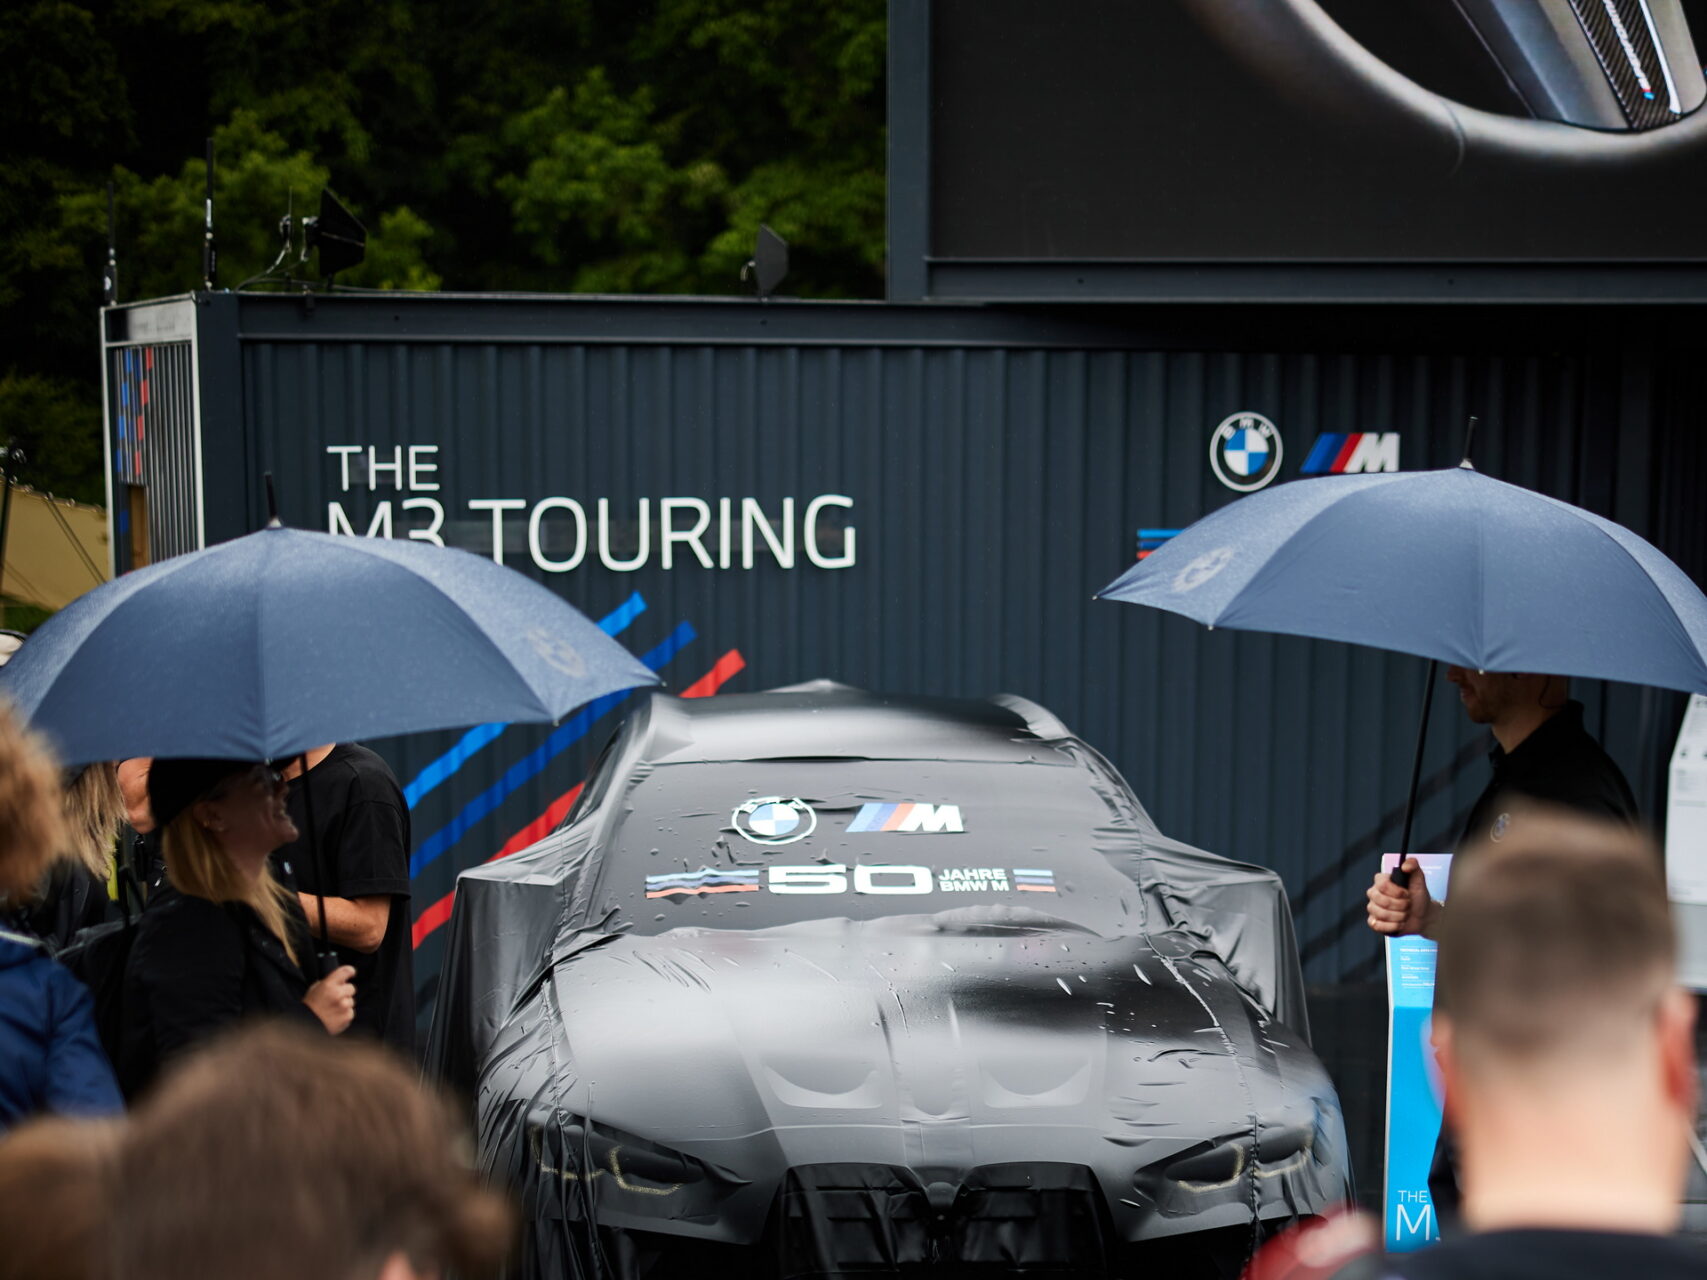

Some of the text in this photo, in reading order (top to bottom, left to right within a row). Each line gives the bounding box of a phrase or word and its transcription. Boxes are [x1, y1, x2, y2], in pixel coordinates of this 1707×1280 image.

[326, 445, 440, 491] THE
[328, 494, 856, 572] M3 TOURING
[768, 863, 933, 895] 50
[939, 868, 1008, 880] JAHRE
[940, 881, 1010, 892] BMW M
[1397, 1190, 1428, 1203] THE
[1396, 1204, 1440, 1241] M
